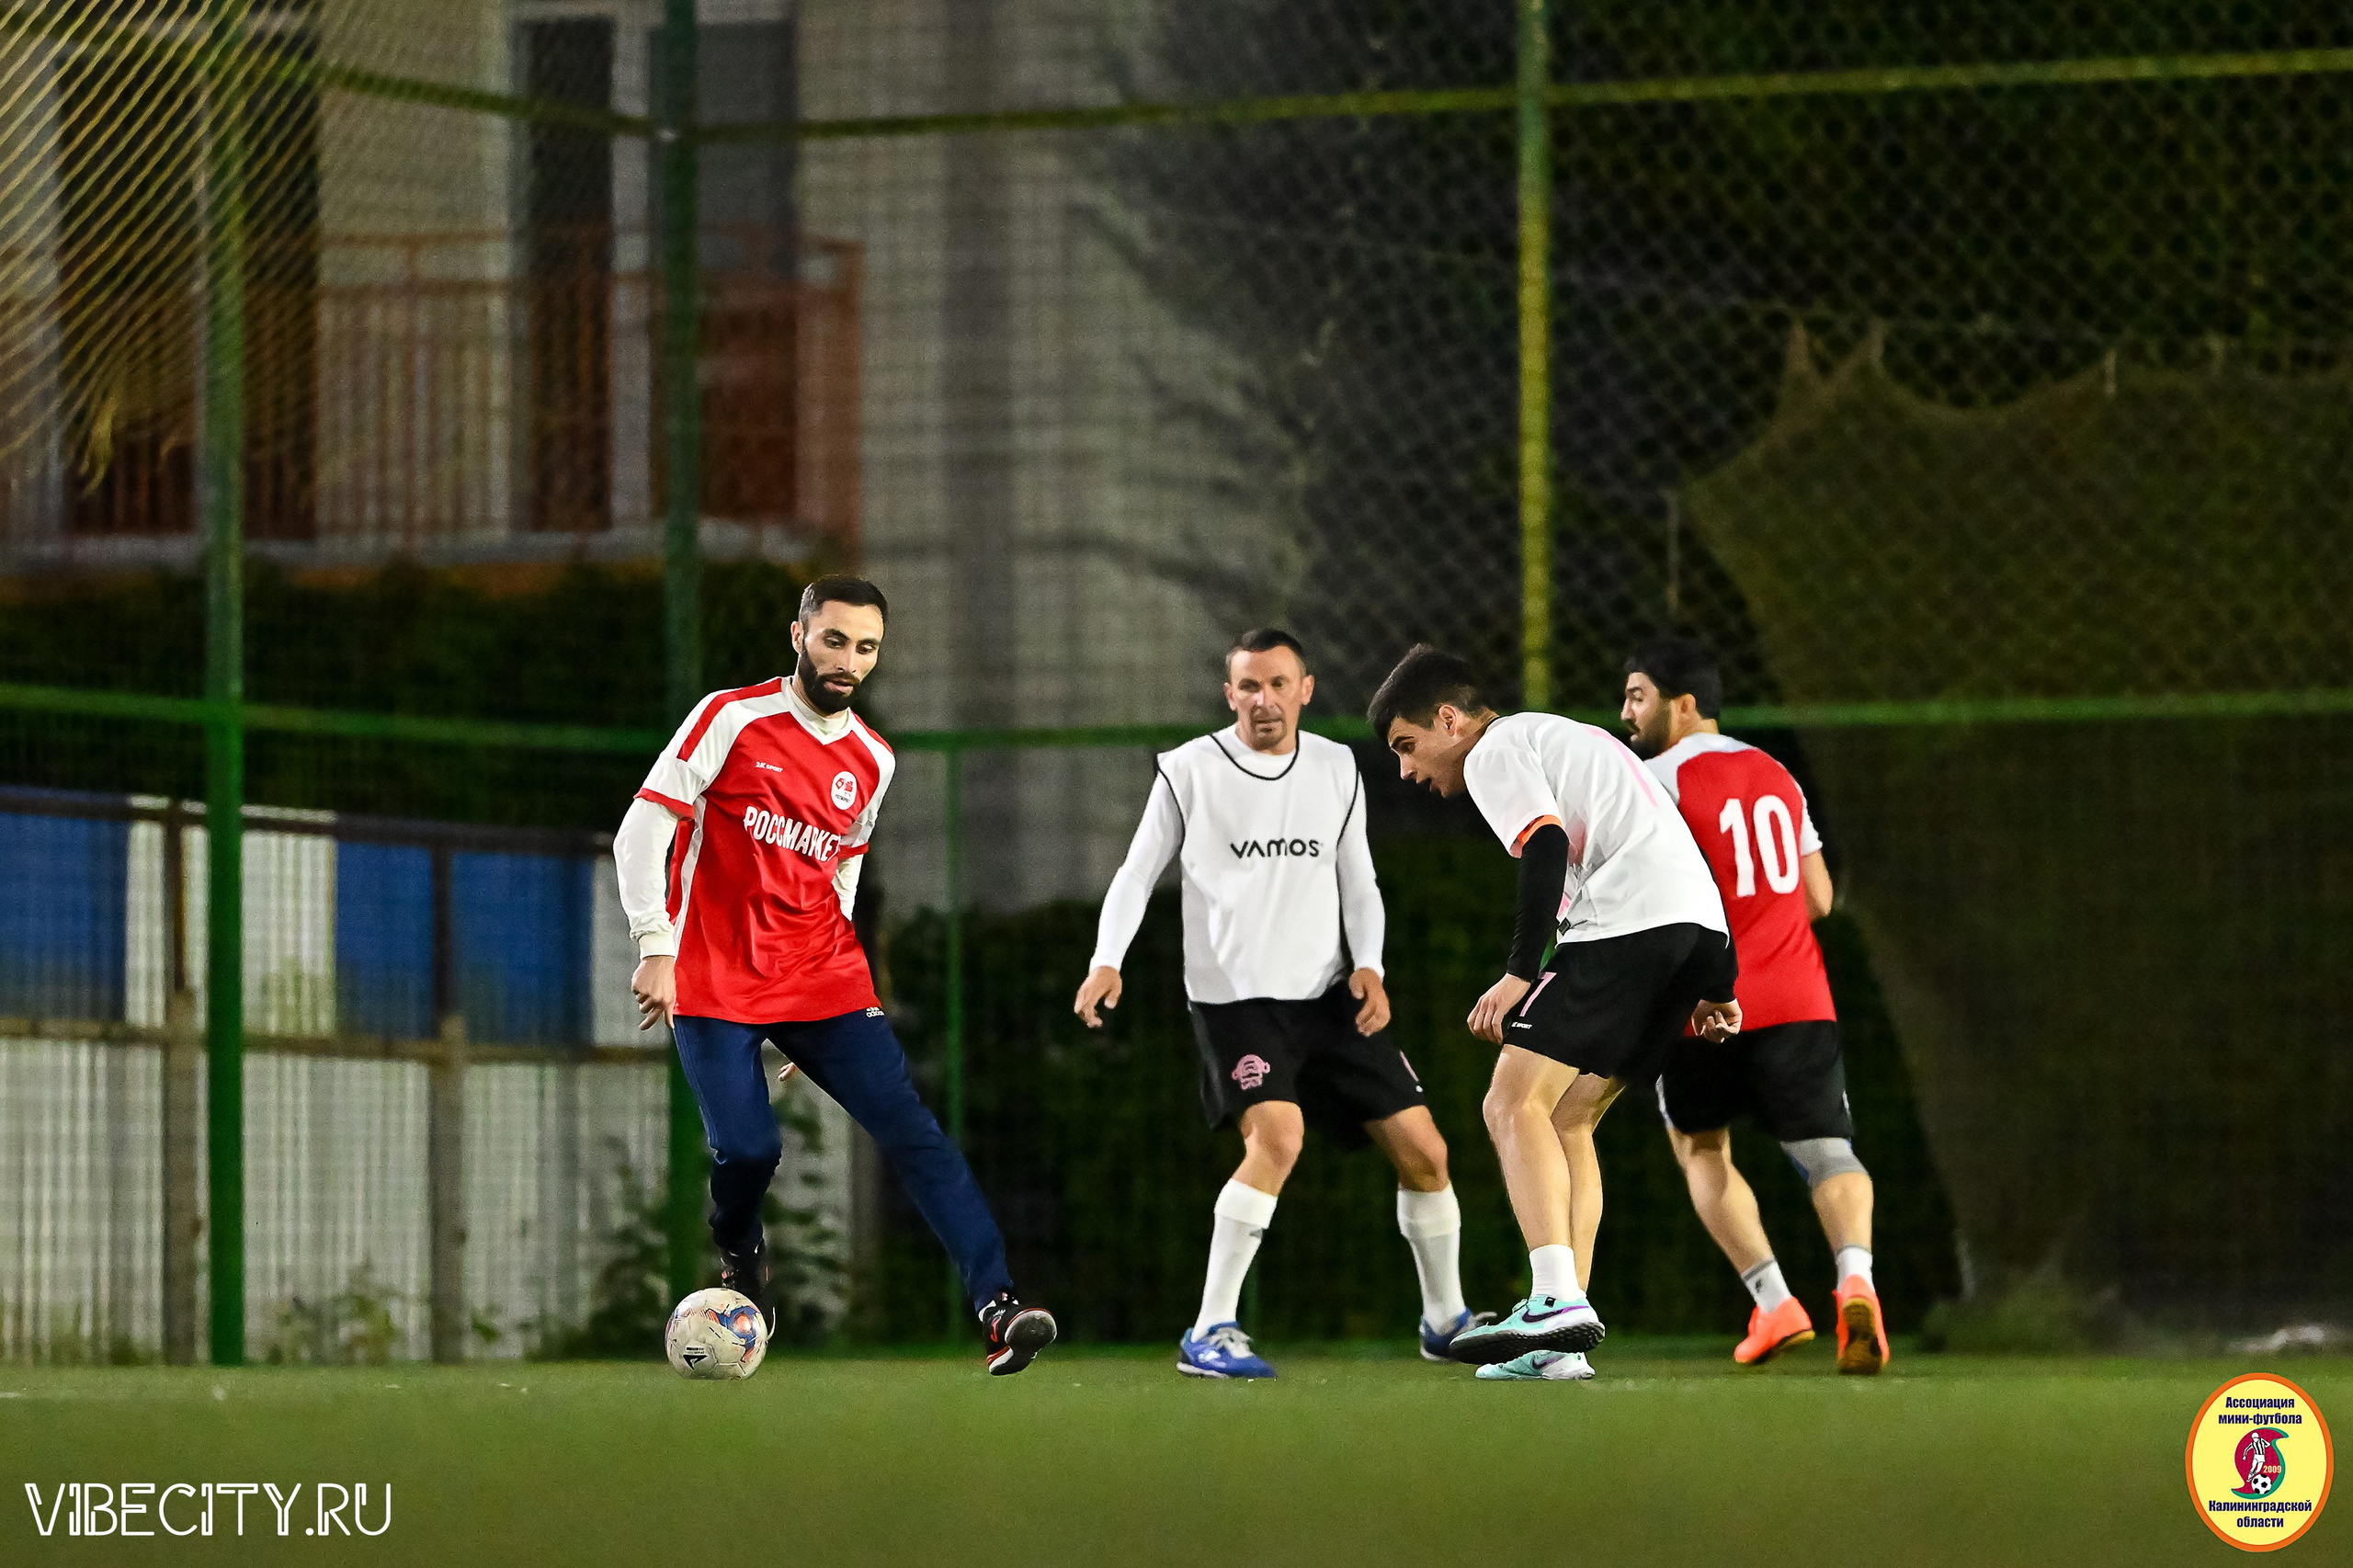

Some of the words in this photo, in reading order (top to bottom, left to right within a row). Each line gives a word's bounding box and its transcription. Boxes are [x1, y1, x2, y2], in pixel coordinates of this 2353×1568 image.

[1230, 837, 1320, 858] VAMOS
[1719, 794, 1801, 897] 10
[1519, 971, 1557, 1017] 7
